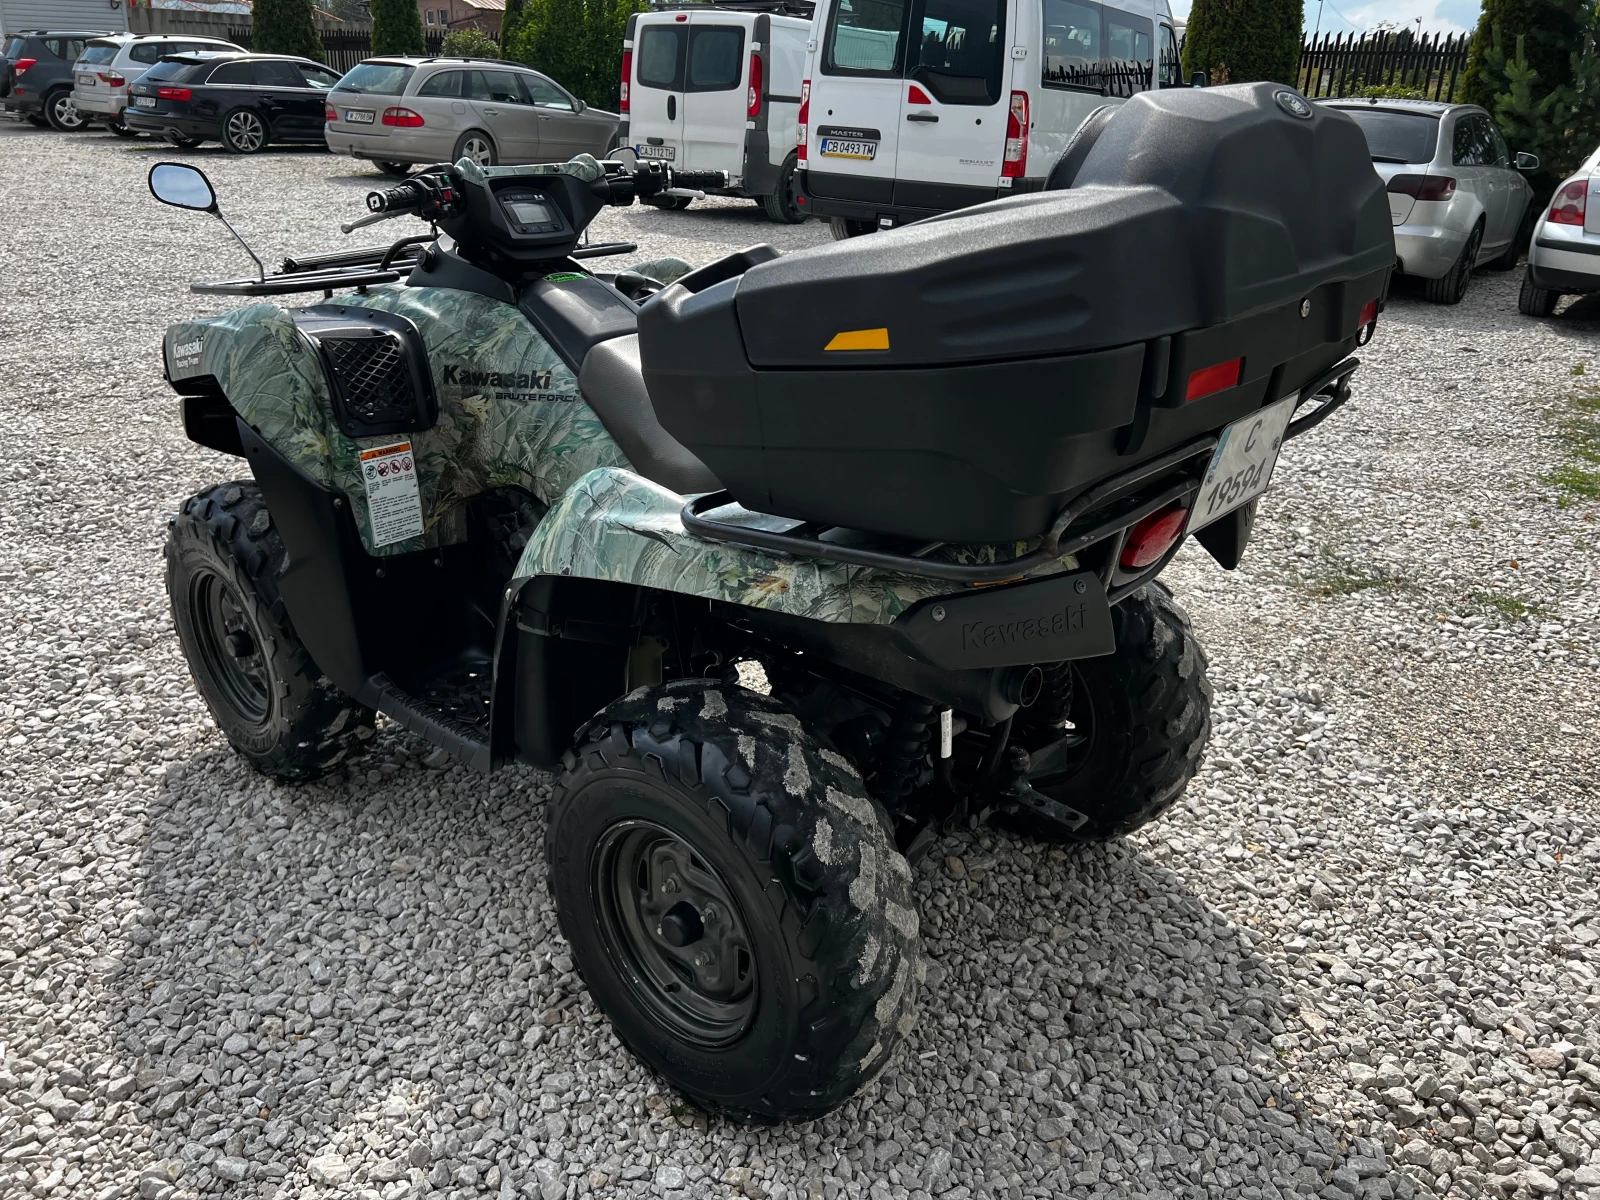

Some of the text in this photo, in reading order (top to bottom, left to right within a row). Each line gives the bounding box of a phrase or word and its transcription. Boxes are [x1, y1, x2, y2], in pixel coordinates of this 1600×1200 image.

[830, 130, 864, 138] MASTER
[827, 141, 875, 156] CB 0493 TM
[173, 335, 204, 359] Kawasaki
[443, 364, 552, 390] Kawasaki
[495, 392, 537, 402] BRUTE
[1244, 418, 1263, 453] C
[1206, 457, 1267, 516] 19594
[961, 602, 1087, 651] Kawasaki
